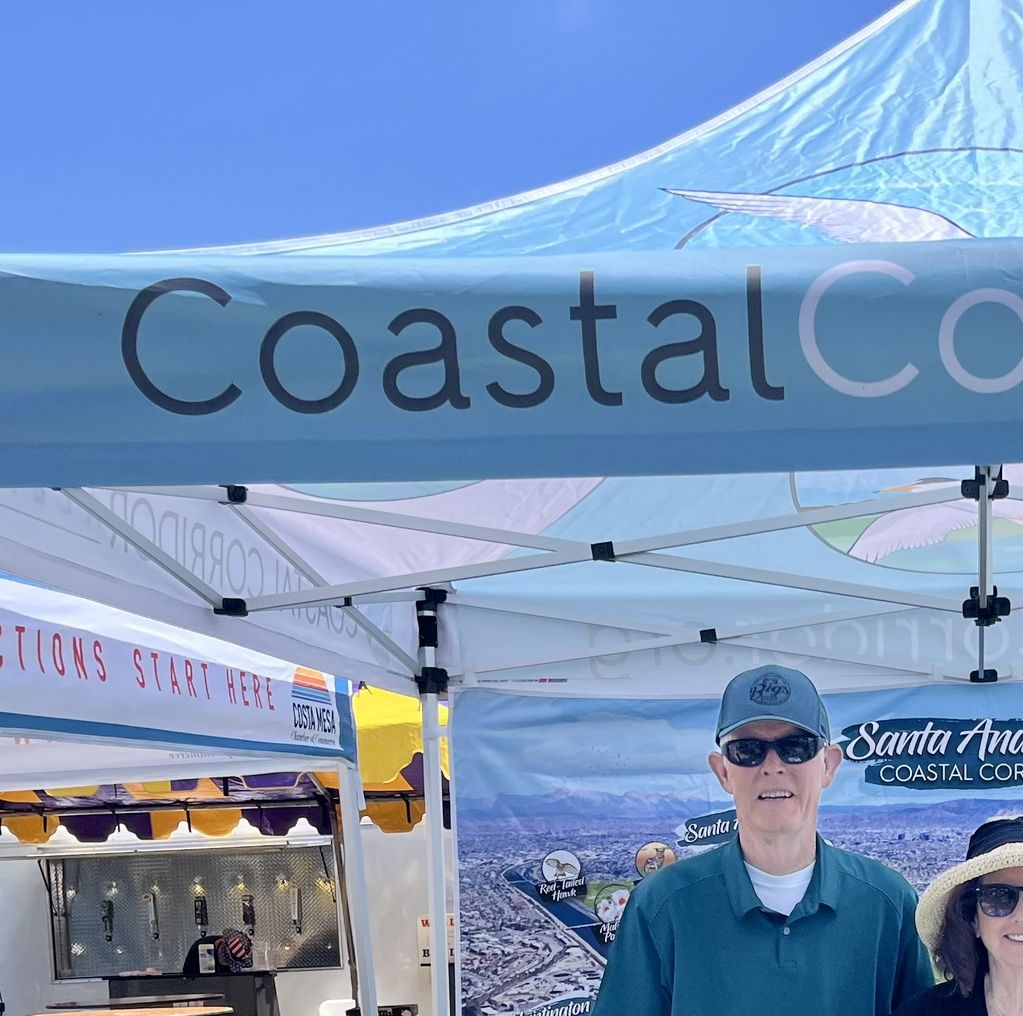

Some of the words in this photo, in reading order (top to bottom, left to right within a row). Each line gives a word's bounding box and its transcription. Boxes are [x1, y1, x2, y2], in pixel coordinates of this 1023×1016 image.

[0, 624, 107, 683] TIONS
[133, 648, 212, 701] START
[225, 668, 276, 711] HERE
[292, 702, 316, 731] COSTA
[315, 706, 337, 735] MESA
[845, 721, 953, 761] Santa
[879, 763, 974, 783] COASTAL
[684, 818, 731, 843] Santa
[539, 876, 585, 895] Red-Tailed
[551, 888, 577, 902] Hawk
